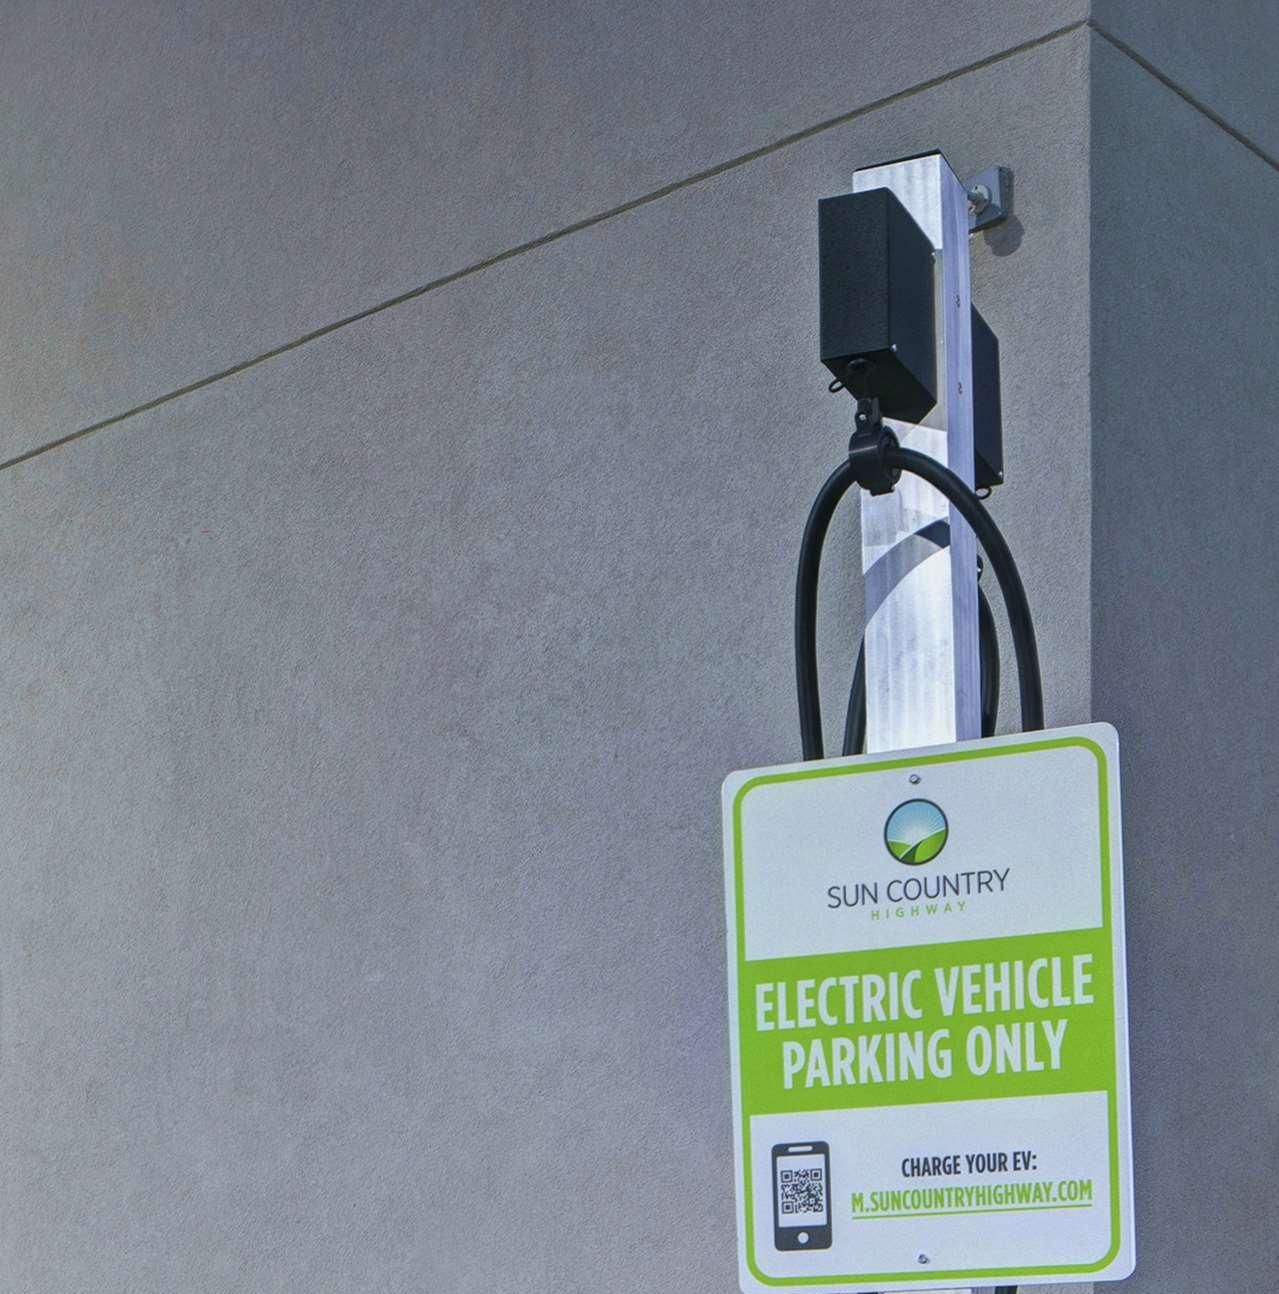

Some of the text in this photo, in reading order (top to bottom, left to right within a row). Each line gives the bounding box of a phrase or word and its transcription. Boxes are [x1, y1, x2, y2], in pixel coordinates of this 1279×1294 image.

[827, 867, 1010, 909] SUN COUNTRY
[871, 901, 967, 920] HIGHWAY
[755, 953, 1095, 1032] ELECTRIC VEHICLE
[782, 1018, 1068, 1089] PARKING ONLY
[901, 1151, 1038, 1178] CHARGE YOUR EV:
[851, 1179, 1093, 1213] M.SUNCOUNTRYHIGHWAY.COM
